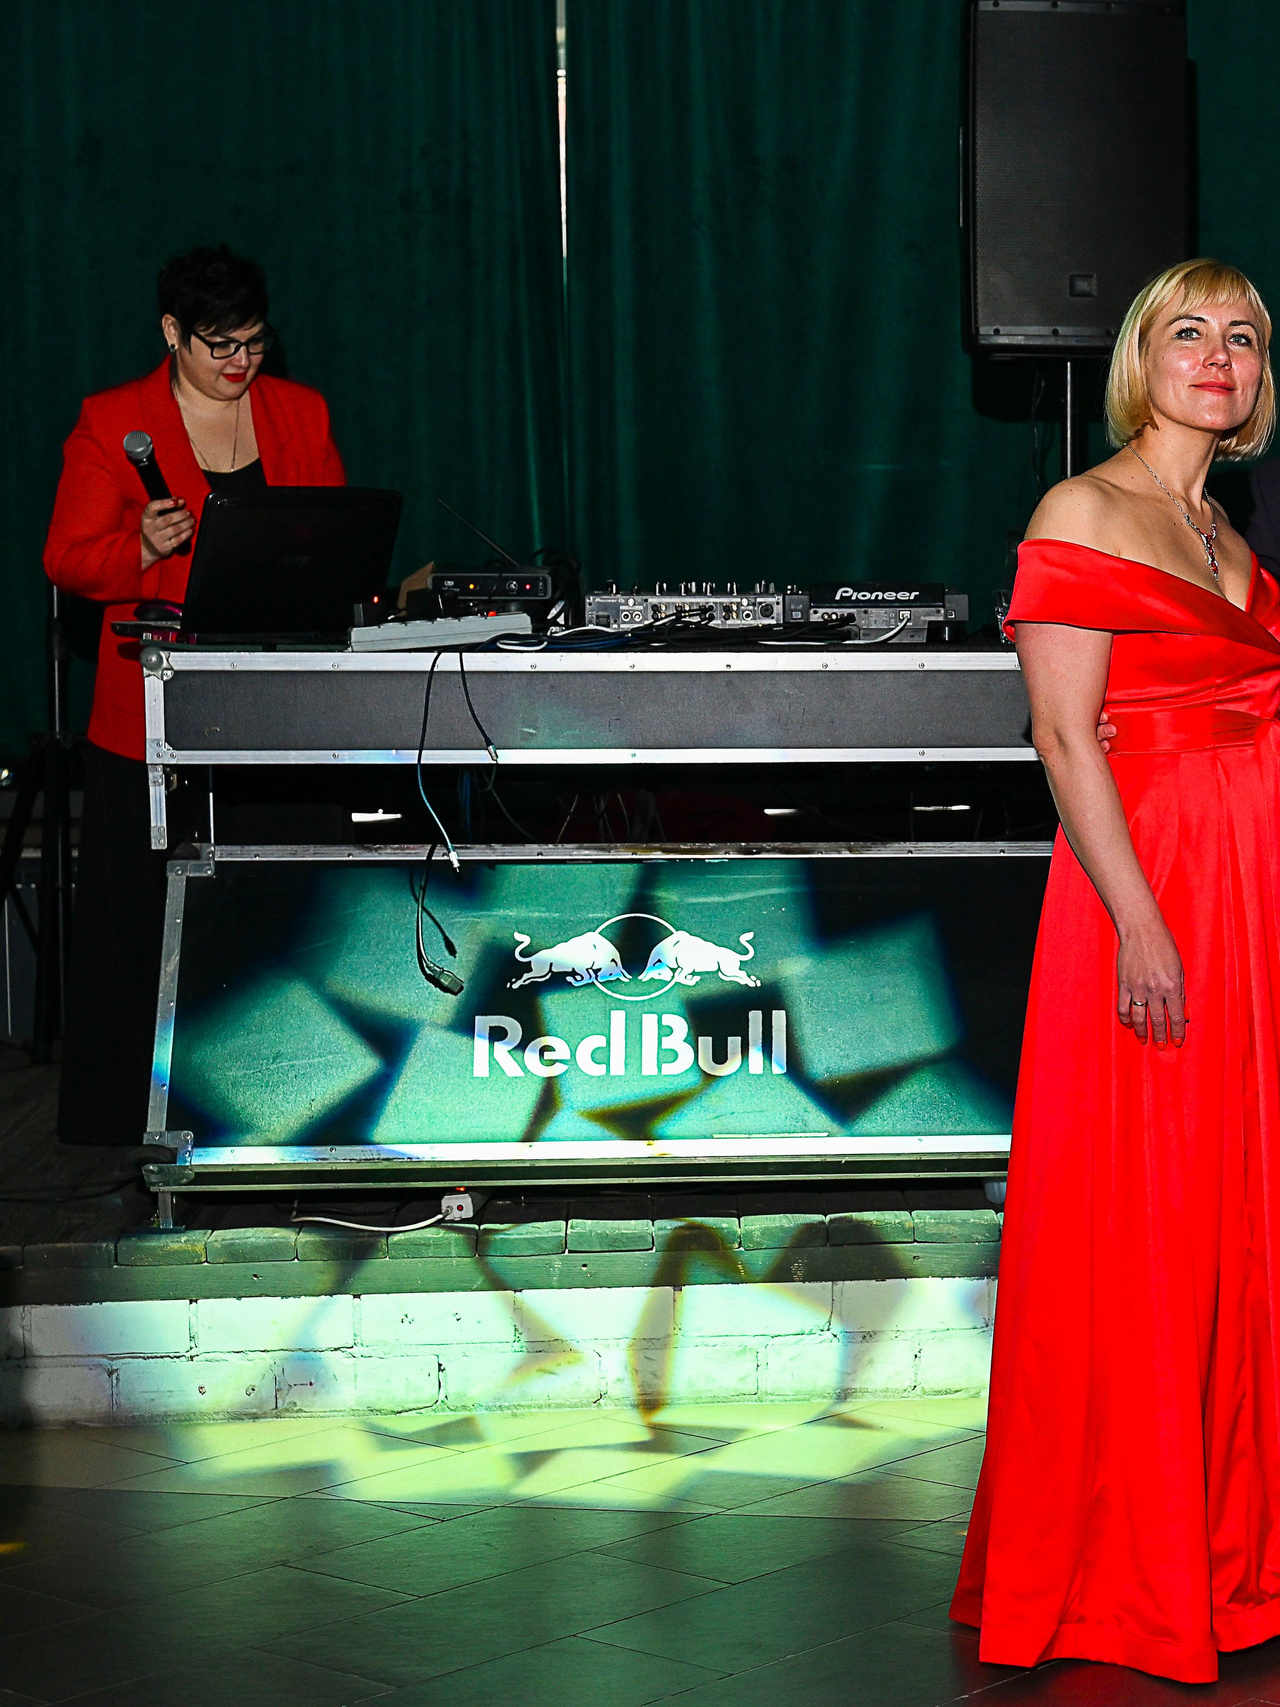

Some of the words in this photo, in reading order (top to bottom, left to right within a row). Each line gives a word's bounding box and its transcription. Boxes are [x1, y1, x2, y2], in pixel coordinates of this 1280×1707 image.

[834, 586, 920, 601] Pioneer
[473, 1009, 626, 1078] Red
[641, 1009, 787, 1077] Bull
